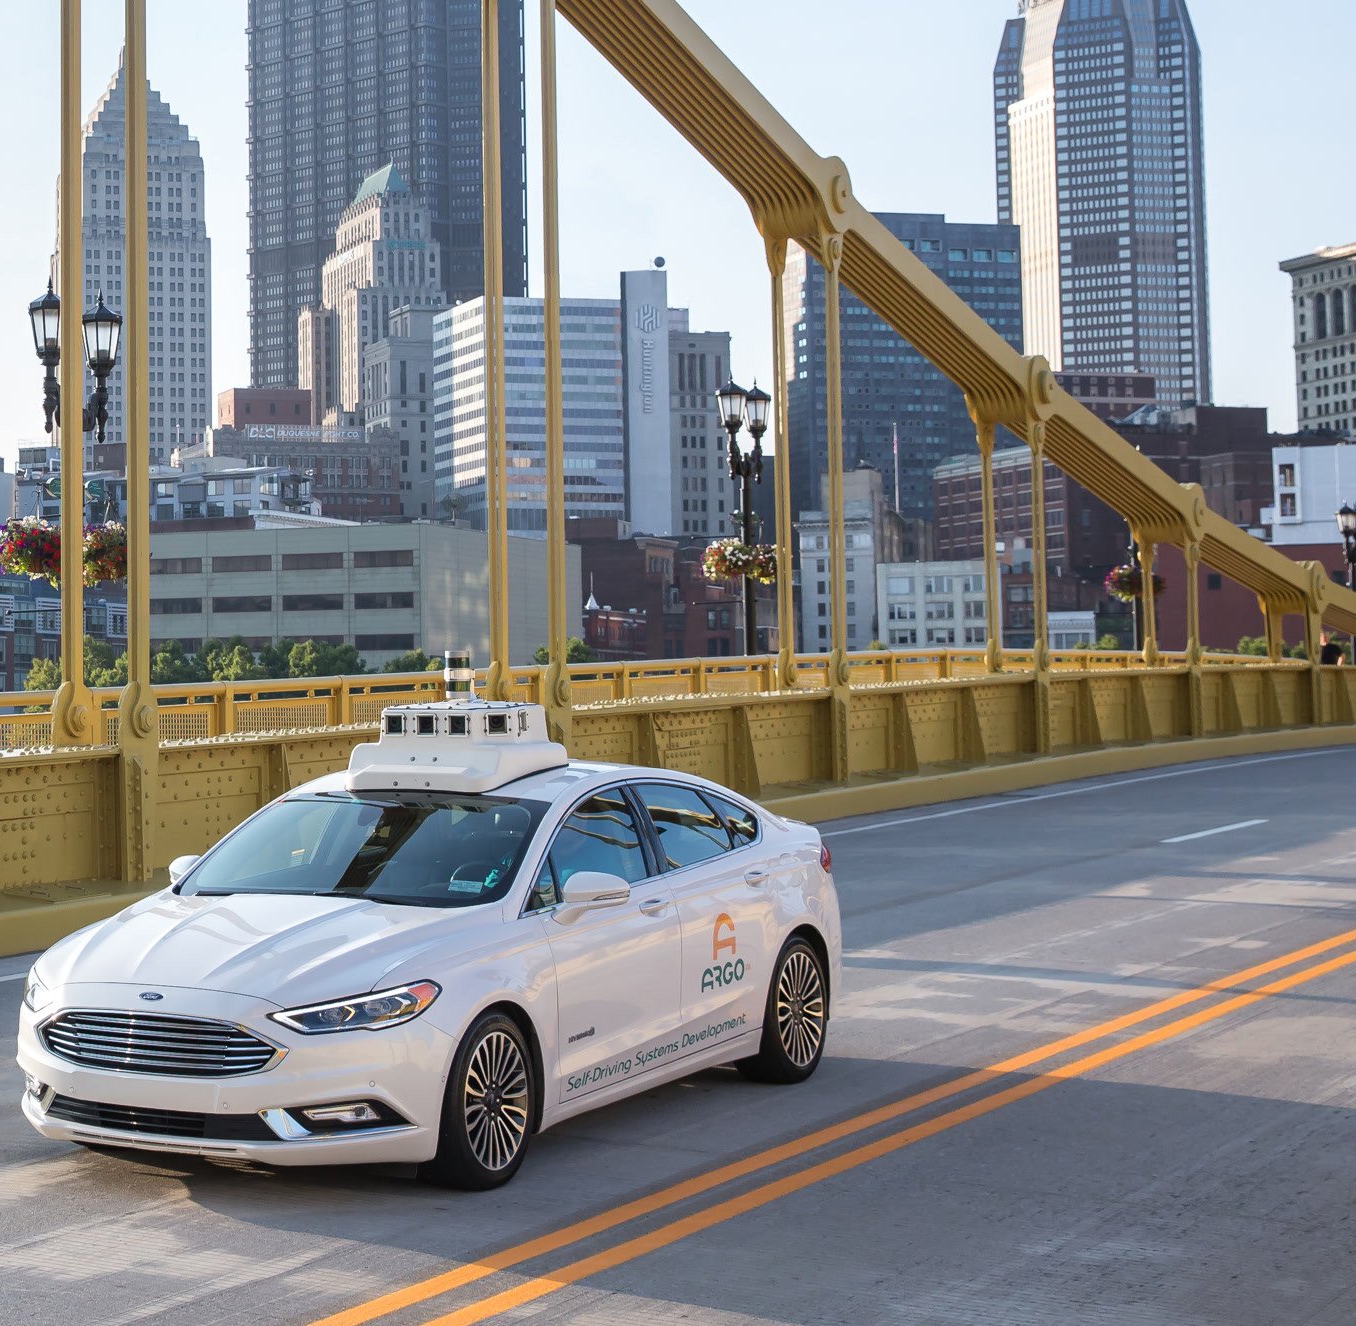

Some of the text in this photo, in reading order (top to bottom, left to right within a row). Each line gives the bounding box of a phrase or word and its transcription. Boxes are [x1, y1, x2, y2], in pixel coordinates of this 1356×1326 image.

[639, 339, 655, 414] Huntington
[701, 958, 745, 993] ARGO
[566, 1012, 746, 1092] Self-Driving Systems Development
